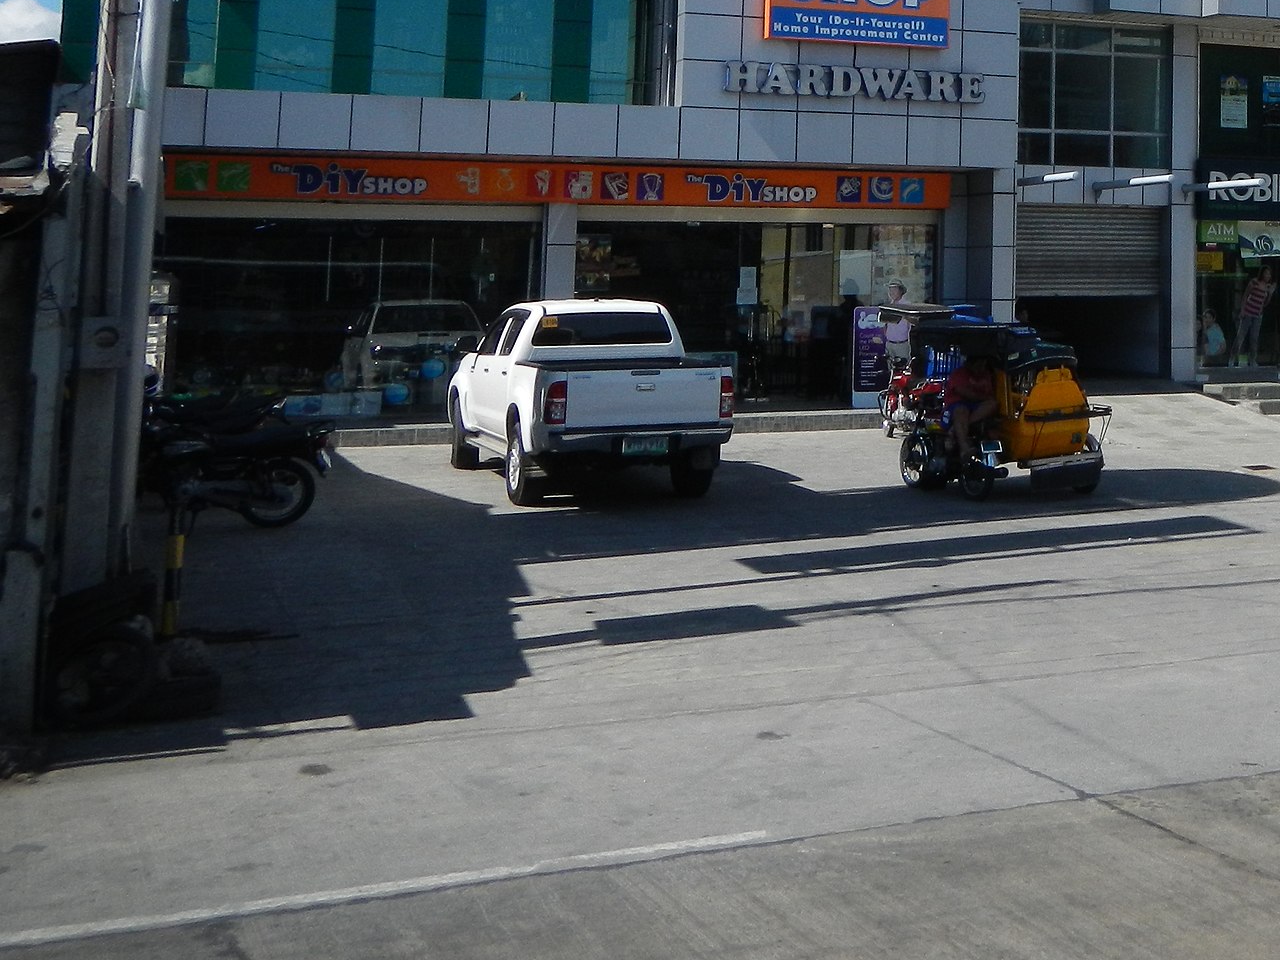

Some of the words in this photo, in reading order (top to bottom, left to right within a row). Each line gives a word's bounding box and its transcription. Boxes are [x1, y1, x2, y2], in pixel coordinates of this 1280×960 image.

[795, 13, 823, 25] Your
[773, 21, 809, 34] Home
[815, 24, 898, 39] Improvement
[904, 31, 945, 42] Center
[724, 60, 985, 104] HARDWARE
[272, 164, 290, 174] The
[291, 162, 368, 195] DiY
[362, 177, 428, 195] SHOP
[686, 174, 705, 184] The
[703, 173, 768, 203] DiY
[762, 187, 818, 203] SHOP
[1207, 224, 1234, 235] ATM
[1257, 238, 1271, 251] 16
